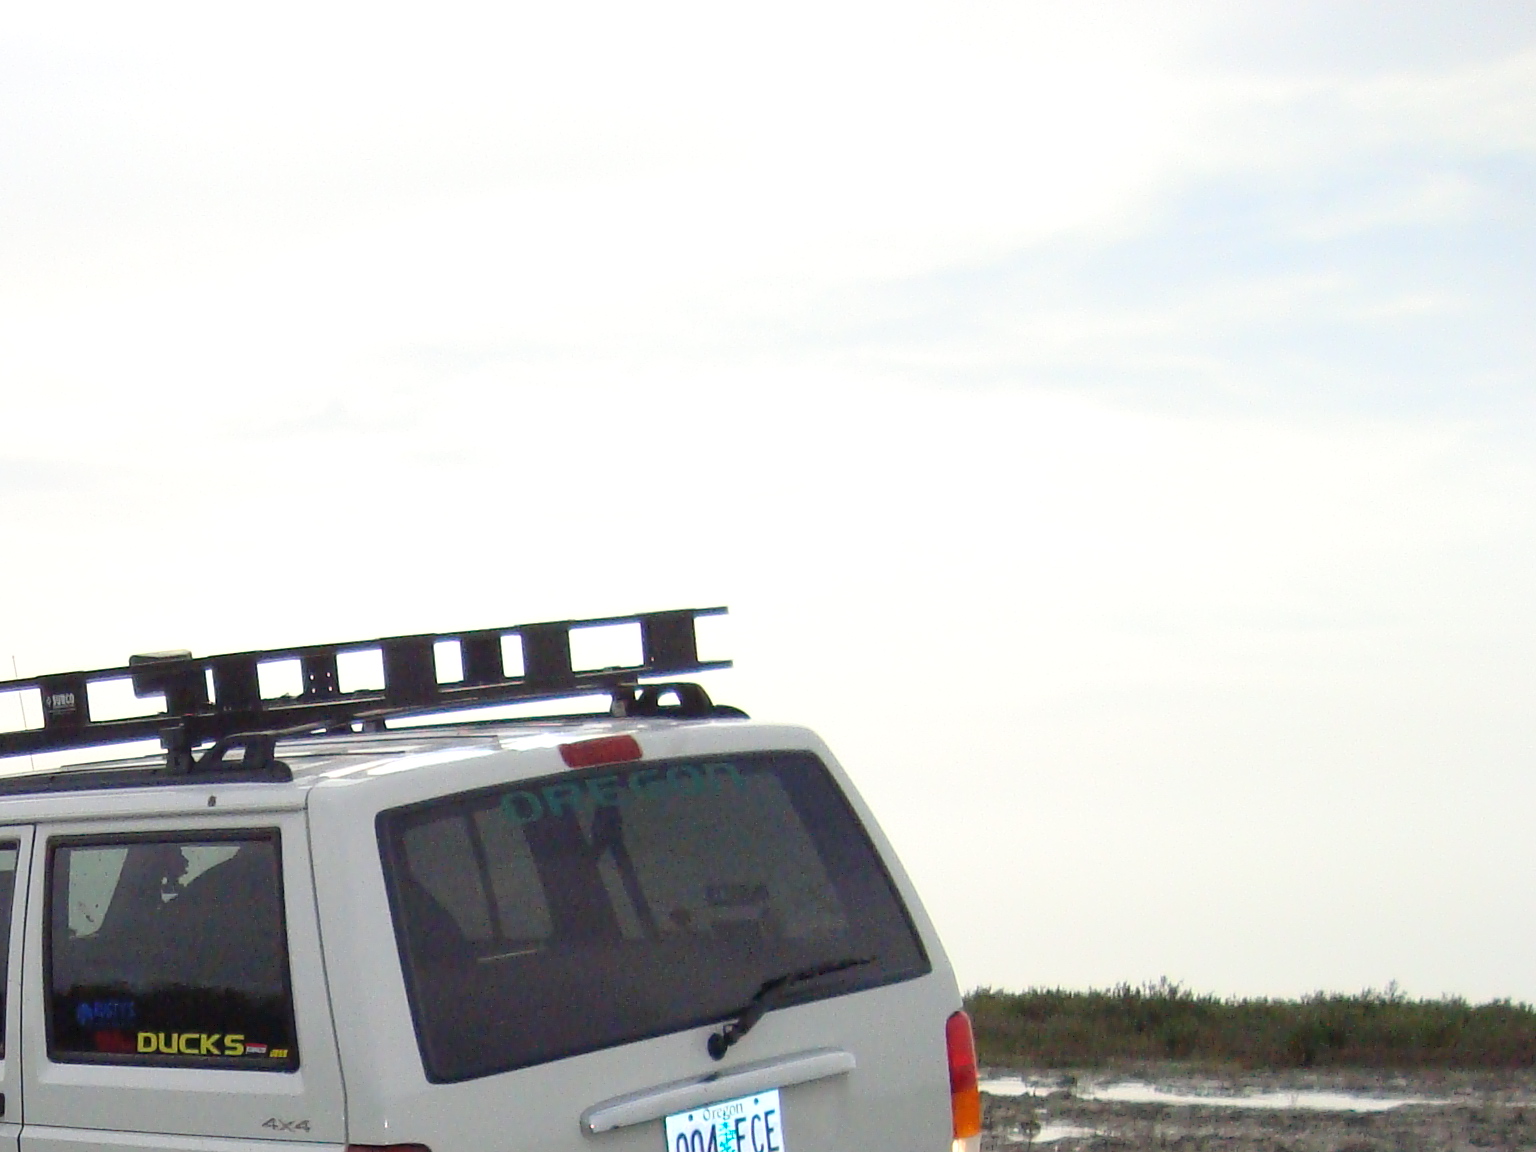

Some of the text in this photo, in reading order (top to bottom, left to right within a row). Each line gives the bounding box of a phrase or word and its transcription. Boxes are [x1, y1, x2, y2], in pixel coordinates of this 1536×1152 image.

[500, 761, 747, 825] OREGON
[137, 1032, 245, 1055] DUCKS
[703, 1103, 743, 1121] Oregon
